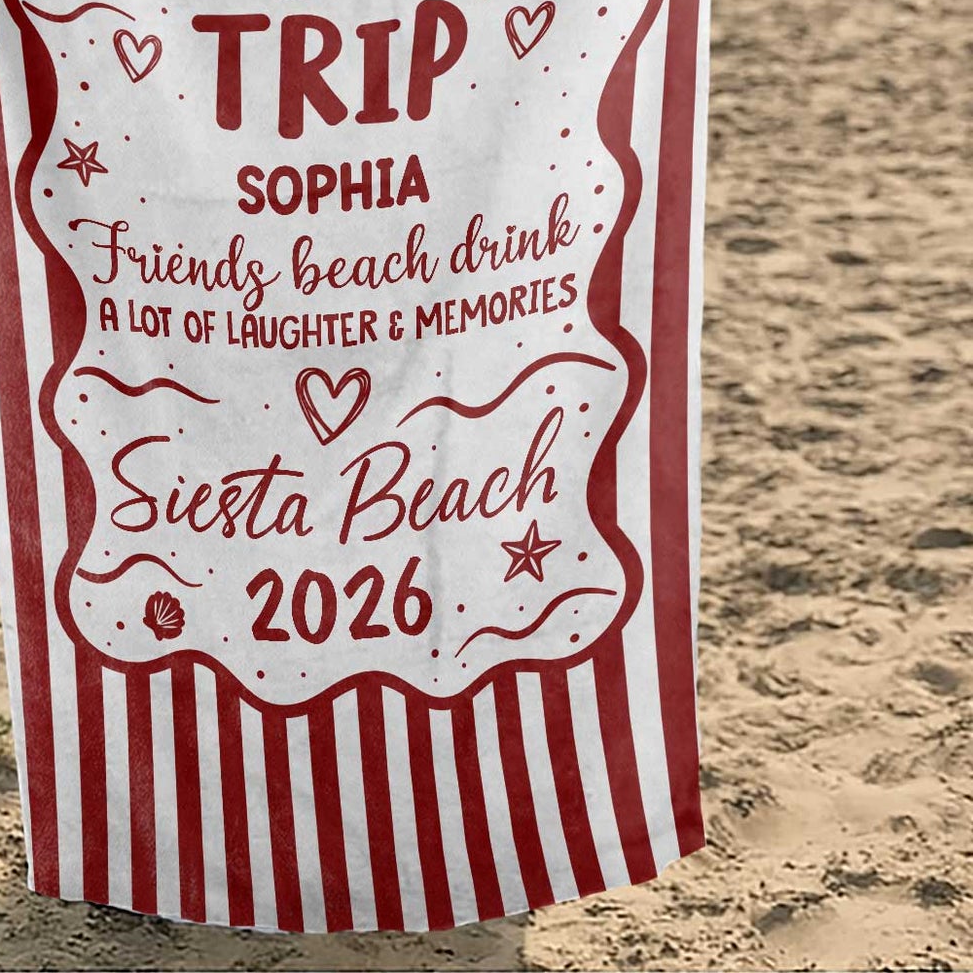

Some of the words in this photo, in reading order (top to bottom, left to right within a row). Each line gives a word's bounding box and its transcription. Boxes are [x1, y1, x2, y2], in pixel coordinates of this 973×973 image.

[191, 0, 468, 140] TRIP
[237, 155, 430, 215] SOPHIA
[69, 218, 281, 310] Friends
[292, 223, 439, 295] beach
[449, 193, 581, 275] drink
[100, 297, 119, 332] A
[129, 301, 172, 339] LOT
[184, 310, 216, 345] OF
[227, 310, 379, 350] LAUGHTER
[416, 273, 579, 338] MEMORIES
[110, 435, 313, 540] Siesta
[339, 407, 565, 544] Beach
[245, 556, 433, 645] 2026
